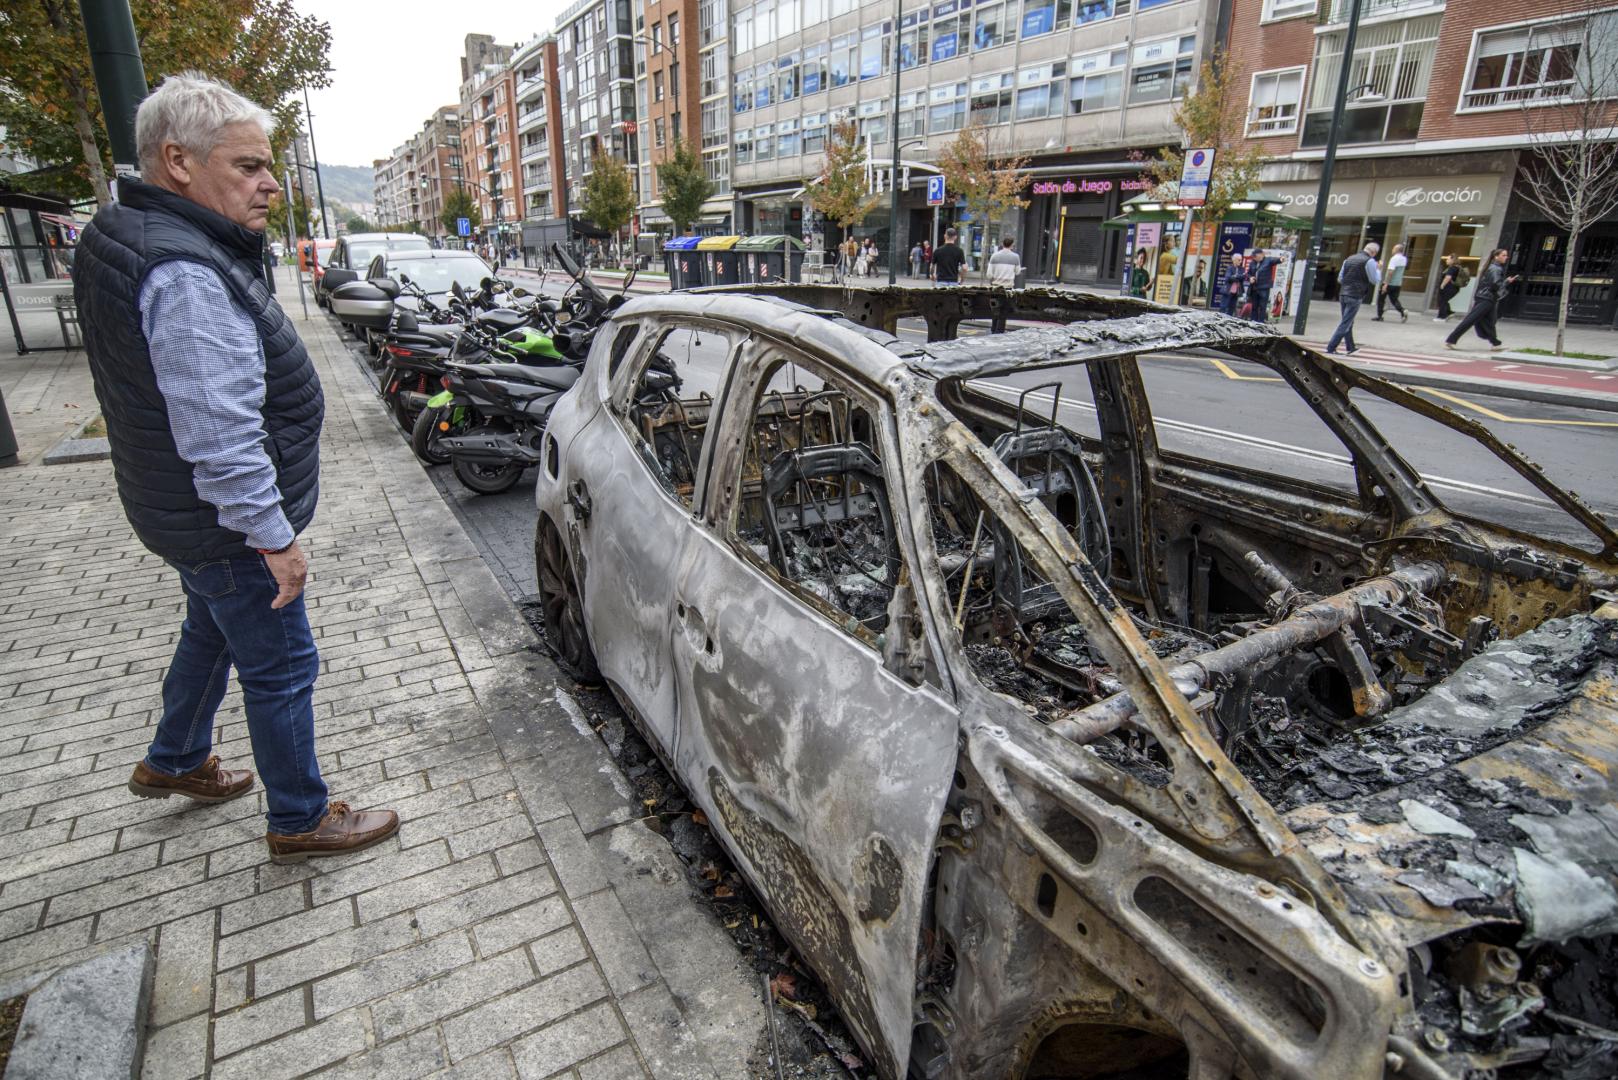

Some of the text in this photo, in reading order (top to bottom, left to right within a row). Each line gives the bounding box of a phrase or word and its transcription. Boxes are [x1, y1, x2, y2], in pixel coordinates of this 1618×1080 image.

[1033, 180, 1112, 194] Salón de Juego
[1295, 193, 1350, 206] cona
[16, 295, 54, 305] Doner
